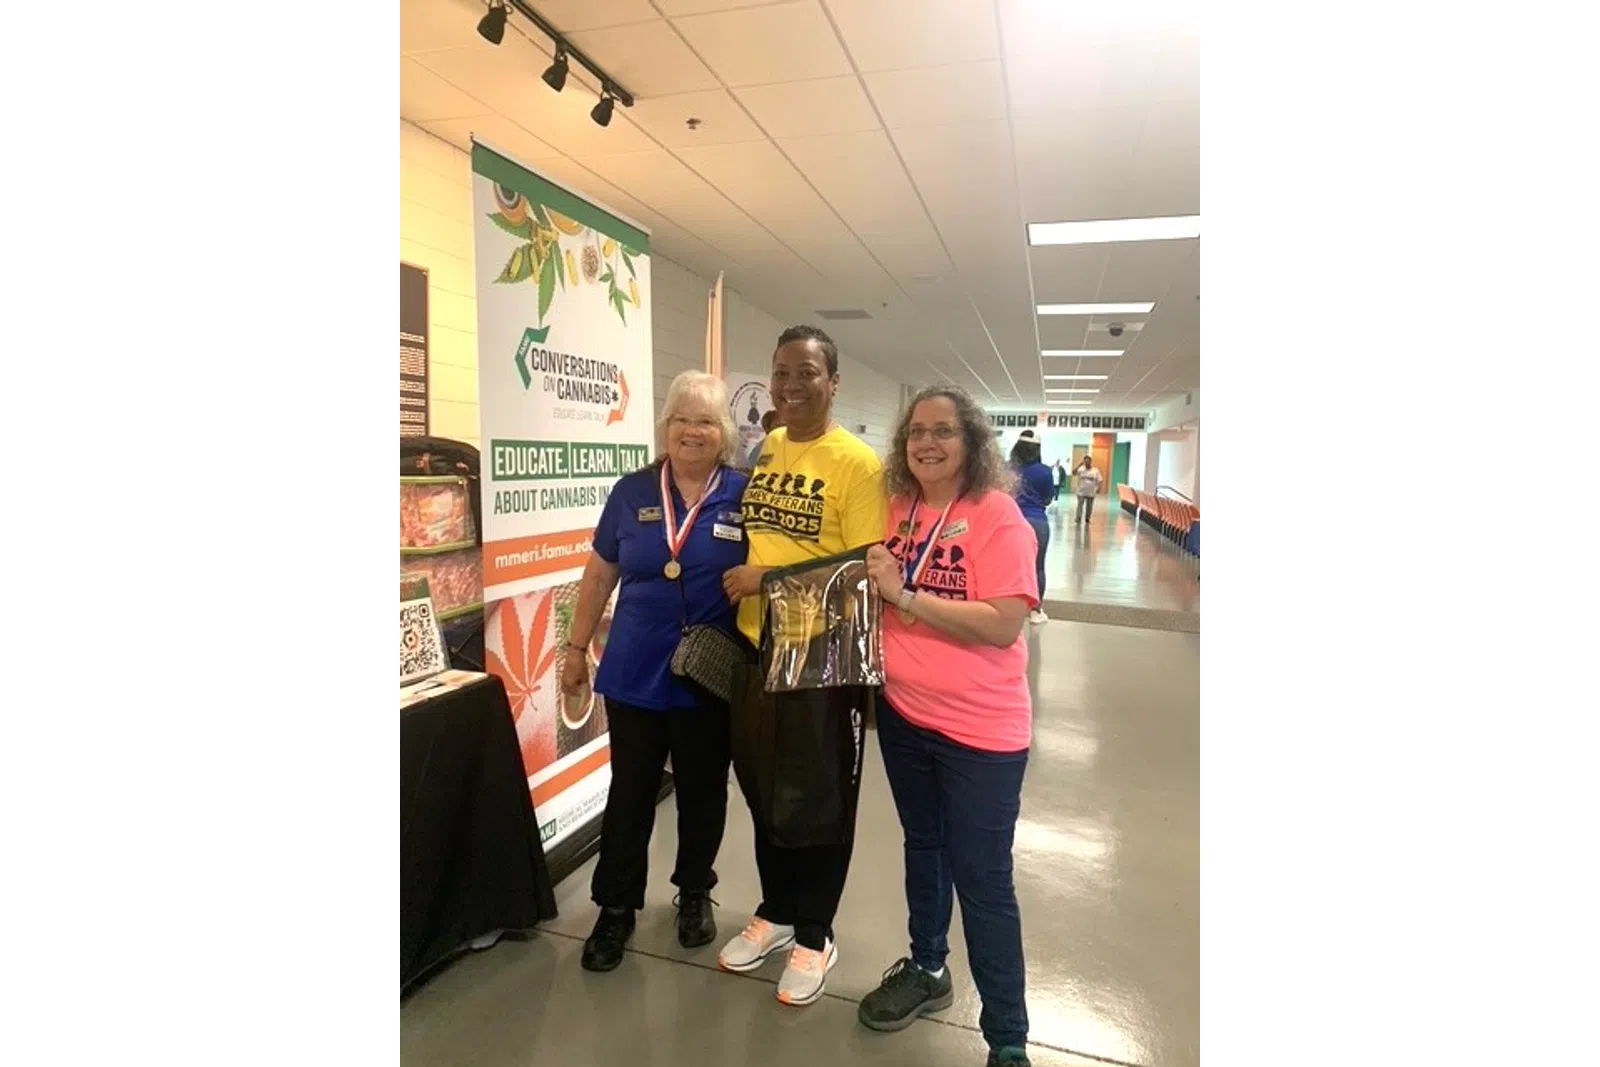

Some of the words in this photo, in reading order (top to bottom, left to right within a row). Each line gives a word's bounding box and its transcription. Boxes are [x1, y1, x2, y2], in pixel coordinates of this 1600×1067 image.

[531, 347, 618, 384] CONVERSATIONS
[543, 375, 556, 393] ON
[557, 378, 611, 405] CANNABIS
[494, 446, 568, 476] EDUCATE.
[573, 448, 617, 473] LEARN.
[494, 489, 538, 515] ABOUT
[541, 486, 597, 511] CANNABIS
[924, 570, 967, 588] ERANS
